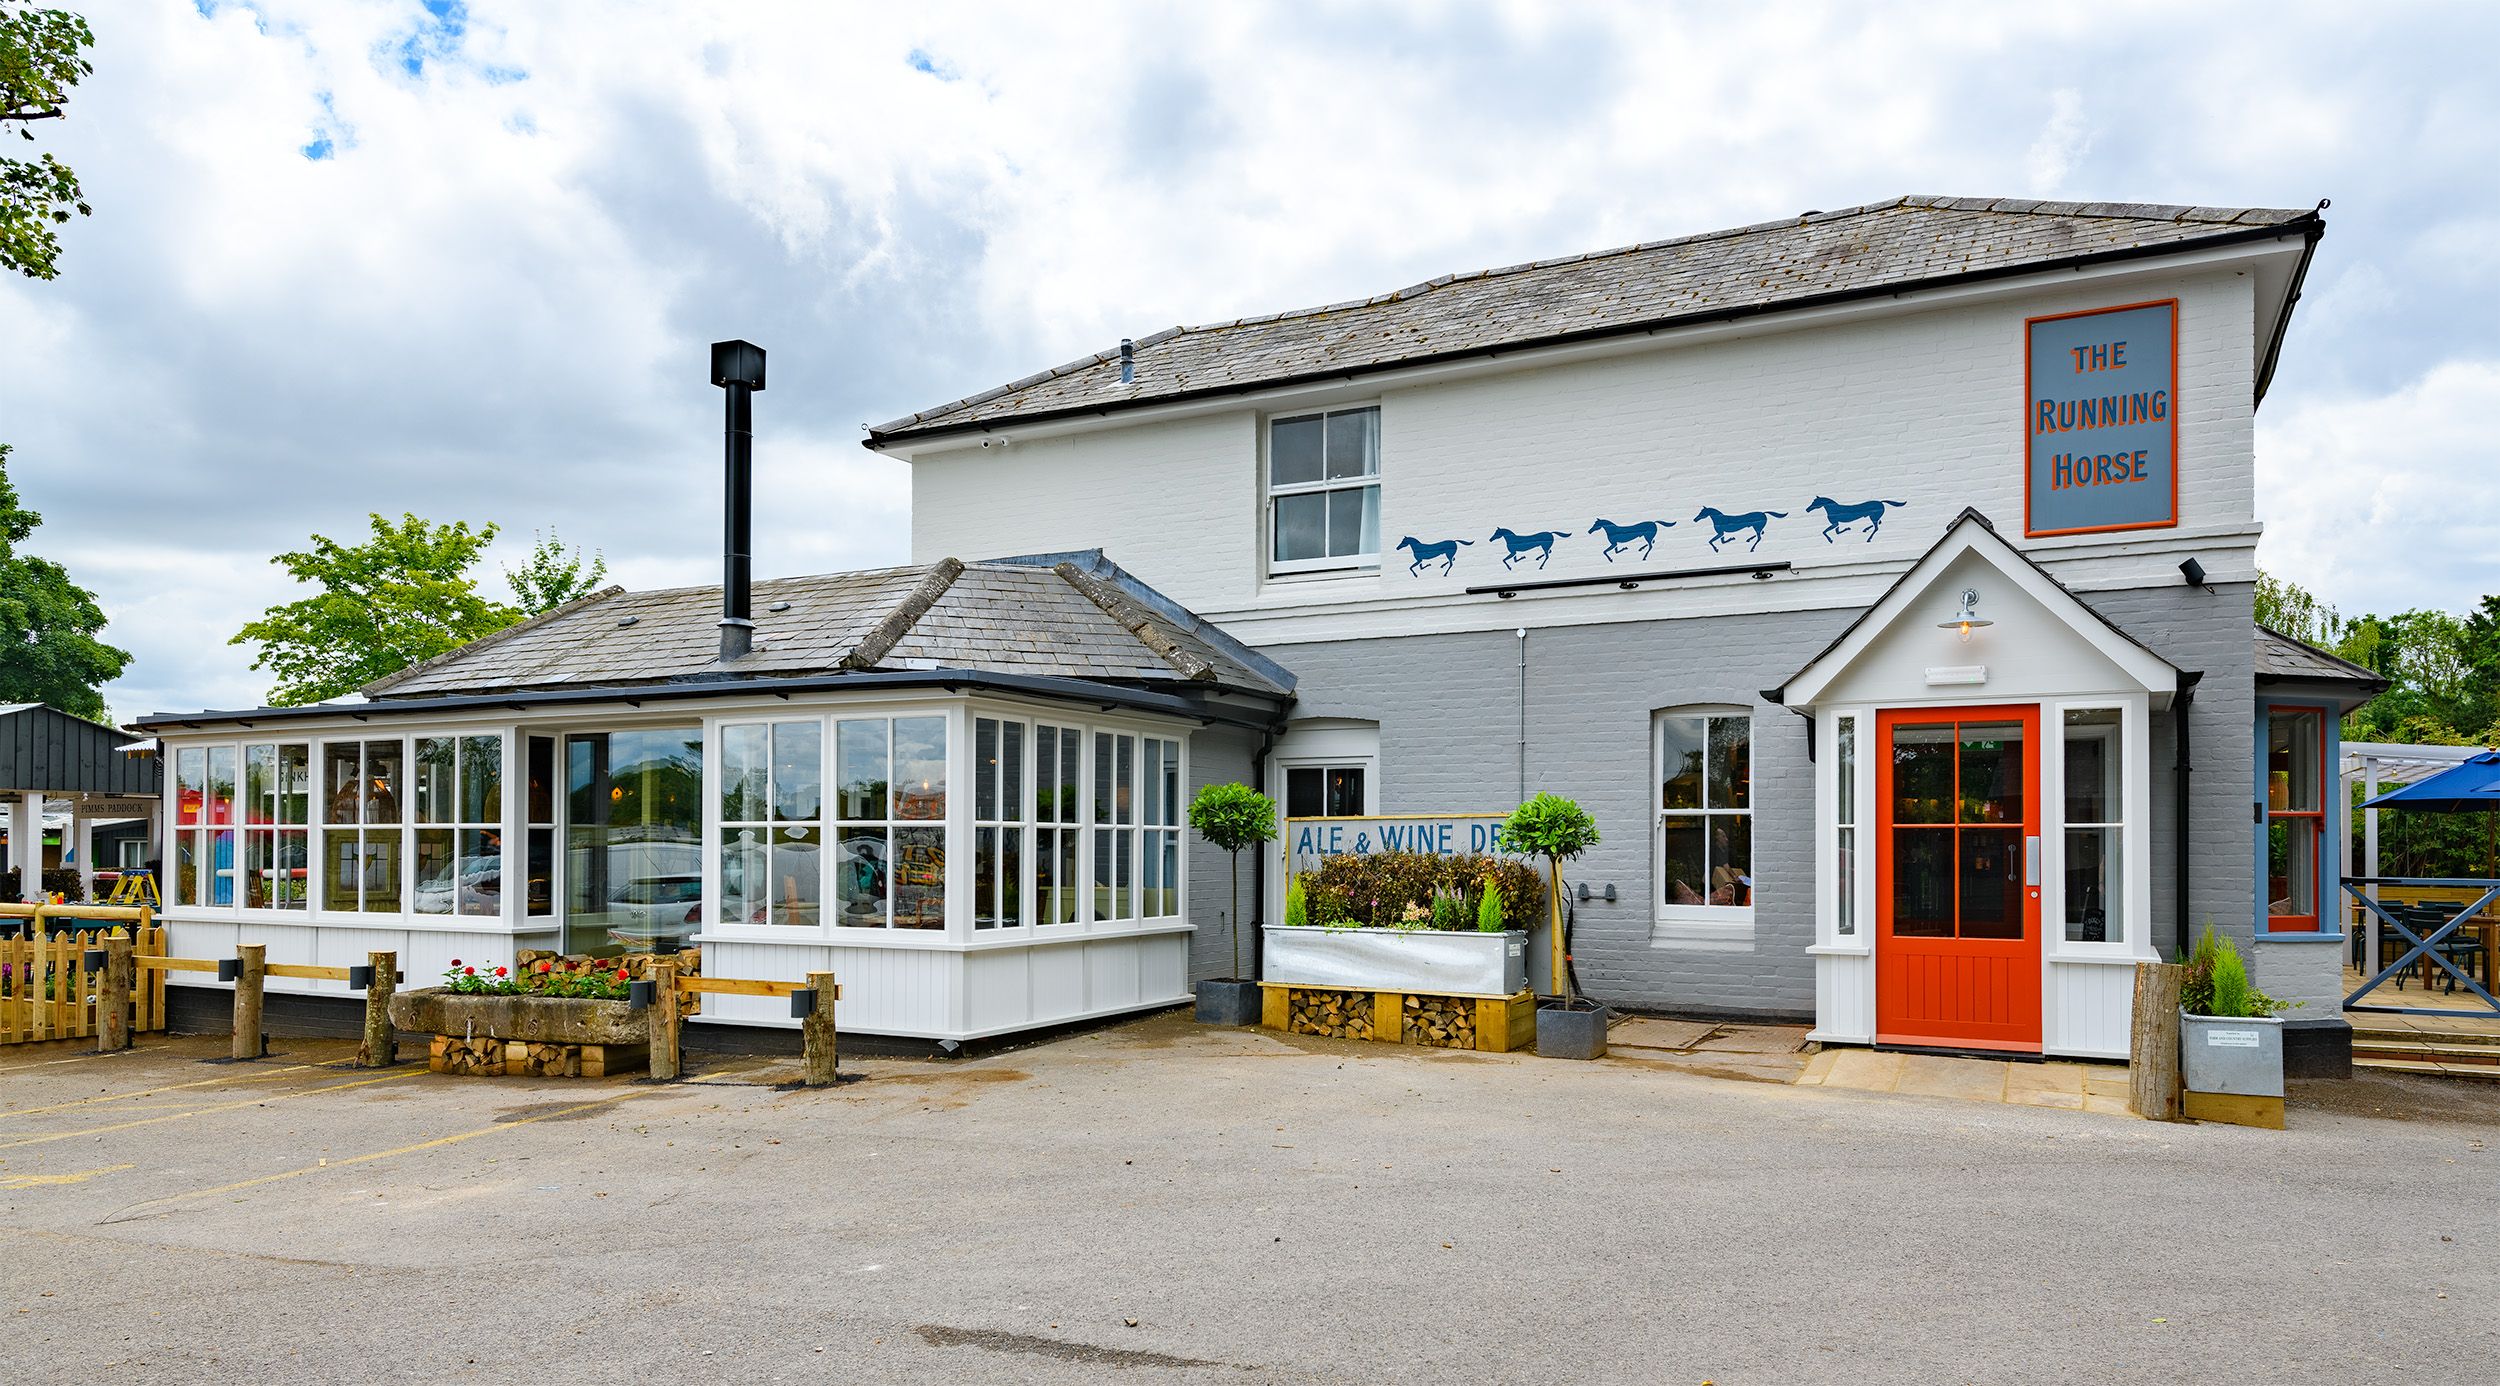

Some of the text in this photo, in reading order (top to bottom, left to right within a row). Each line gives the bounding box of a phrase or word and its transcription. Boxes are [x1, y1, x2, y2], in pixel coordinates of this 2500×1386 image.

[2070, 340, 2128, 374] THE
[2035, 389, 2167, 435] RUNNING
[2051, 449, 2149, 491] HORSE
[81, 803, 143, 814] PIMMS PADDOCK
[1296, 823, 1521, 855] ALE & WINE DR
